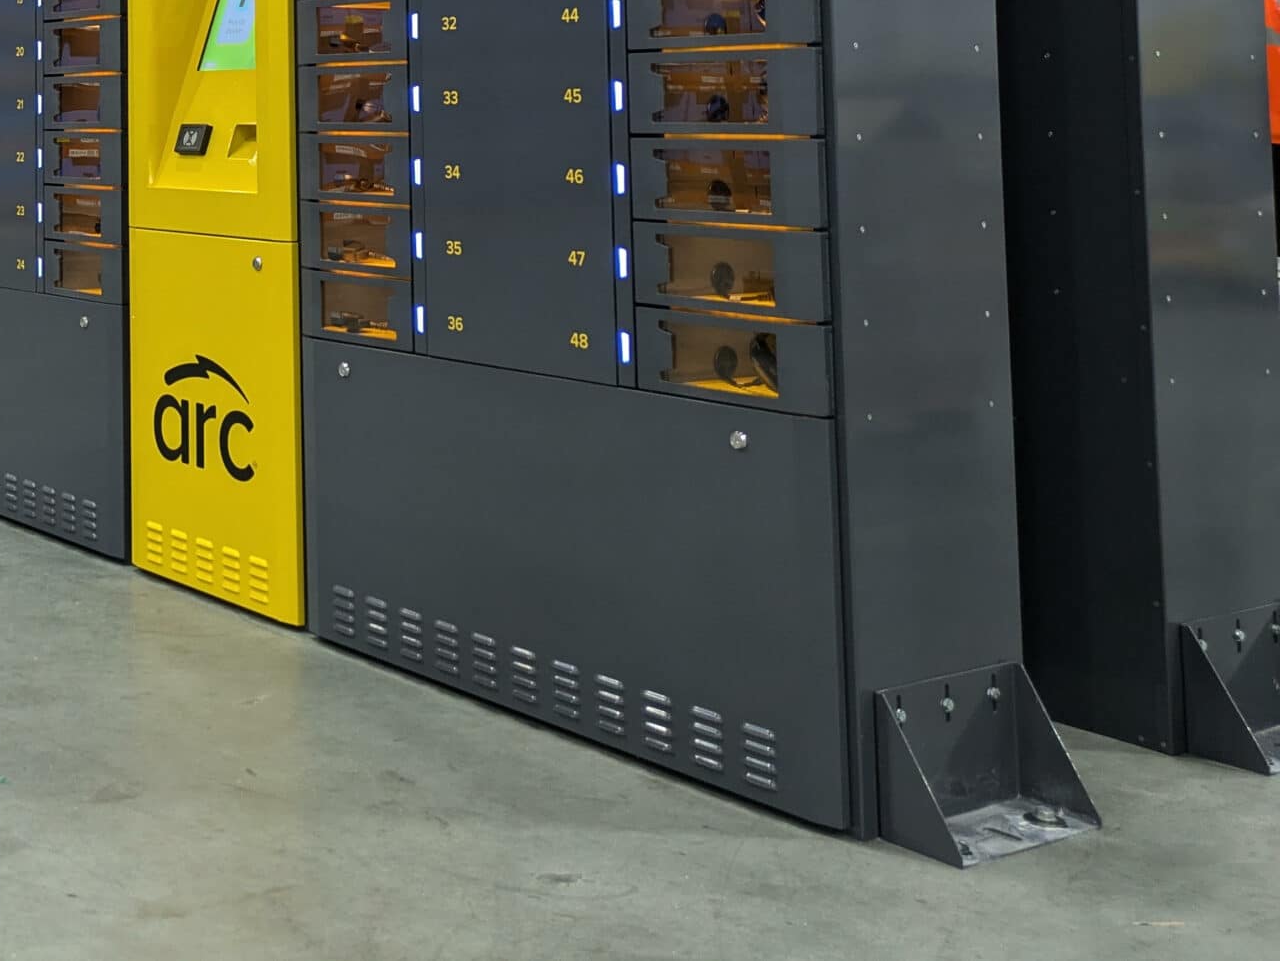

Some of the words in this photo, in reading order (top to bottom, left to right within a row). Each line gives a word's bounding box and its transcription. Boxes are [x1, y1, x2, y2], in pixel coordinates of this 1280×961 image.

[561, 6, 580, 22] 44
[441, 16, 457, 31] 32
[16, 47, 25, 56] 20
[443, 89, 459, 106] 33
[564, 87, 583, 104] 45
[16, 99, 24, 109] 21
[16, 151, 25, 163] 22
[445, 164, 461, 180] 34
[565, 168, 585, 185] 46
[16, 205, 26, 217] 23
[447, 239, 463, 256] 35
[16, 259, 26, 270] 24
[568, 249, 587, 266] 47
[448, 315, 464, 332] 36
[569, 331, 590, 350] 48
[154, 394, 255, 482] arc
